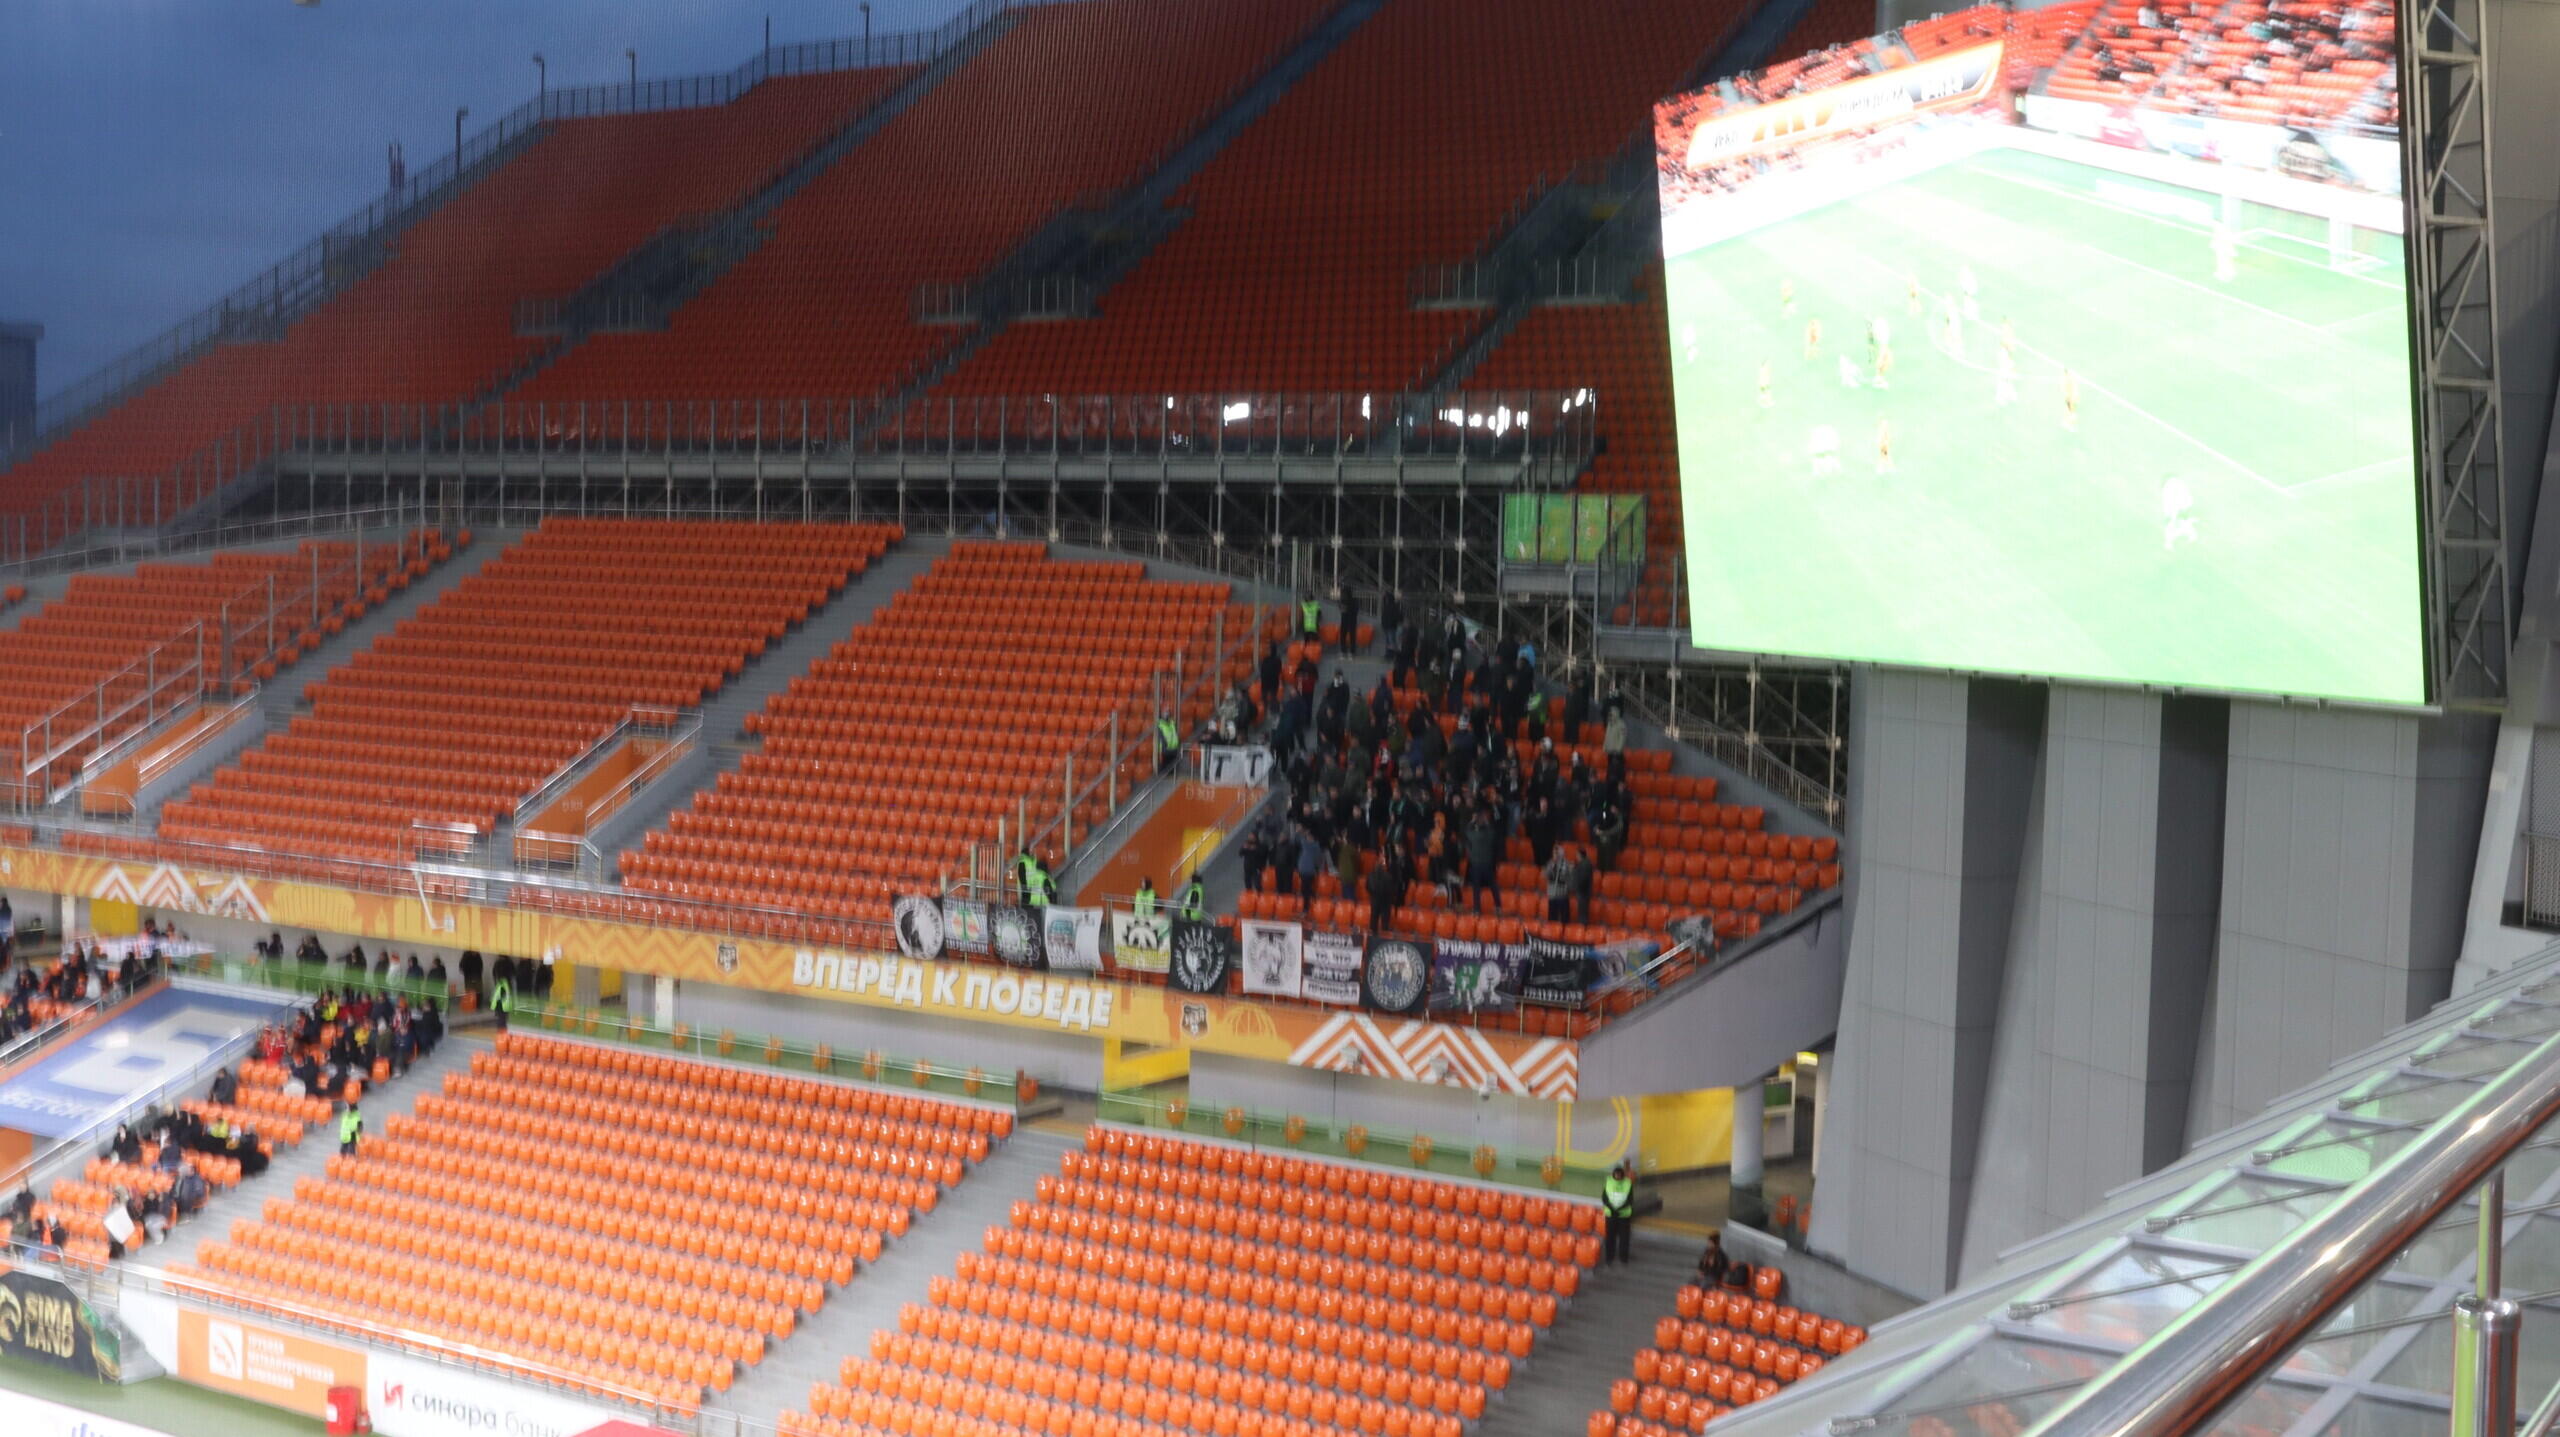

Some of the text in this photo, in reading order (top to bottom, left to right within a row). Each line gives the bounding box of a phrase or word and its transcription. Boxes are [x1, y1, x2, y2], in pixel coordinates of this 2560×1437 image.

[1438, 939, 1481, 958] STUPINO
[1485, 943, 1500, 960] ON
[793, 949, 1114, 1031] ВПЕРЁД К ПОБЕДЕ
[24, 1291, 74, 1332] SIMA
[25, 1321, 75, 1358] LAND
[411, 1391, 497, 1428] синара
